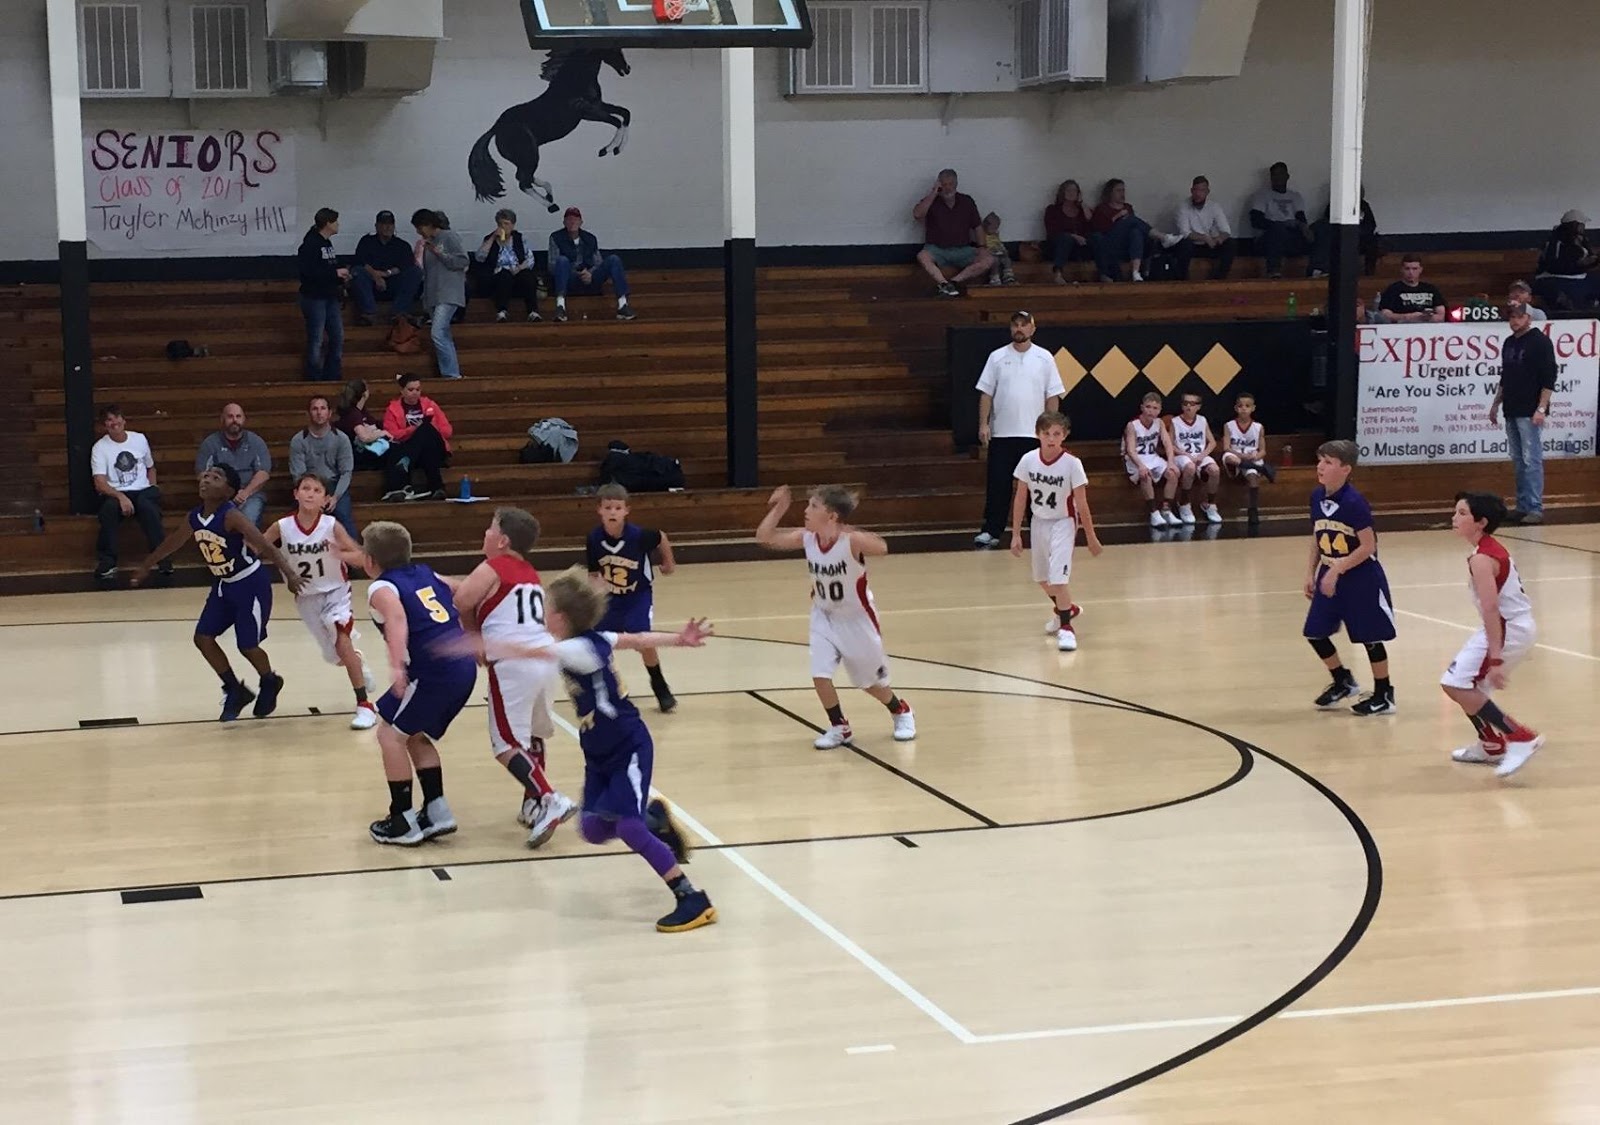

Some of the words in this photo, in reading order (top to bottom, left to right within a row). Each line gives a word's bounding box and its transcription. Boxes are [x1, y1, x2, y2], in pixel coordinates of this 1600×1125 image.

[91, 129, 280, 187] SENIORS
[99, 175, 152, 202] Class
[165, 175, 184, 205] of
[201, 176, 245, 203] 2017
[91, 204, 169, 239] Tayler
[176, 207, 247, 236] McKinzy
[255, 207, 286, 232] Hill
[1354, 327, 1499, 378] Express
[1541, 321, 1597, 358] ed
[1418, 362, 1471, 381] Urgent
[1475, 362, 1503, 376] Car
[1405, 385, 1431, 398] You
[1436, 383, 1475, 397] Sick?
[1553, 380, 1581, 393] ck!”
[1138, 443, 1156, 455] 20
[1184, 442, 1202, 454] 25
[1374, 442, 1445, 459] Mustangs
[1449, 440, 1476, 454] and
[1481, 439, 1508, 453] Lad
[1543, 436, 1594, 454] stangs!
[1034, 489, 1057, 509] 24
[199, 541, 226, 563] 02
[1319, 532, 1350, 555] 44
[297, 558, 325, 579] 21
[603, 565, 628, 587] 12
[815, 580, 844, 601] 00
[415, 586, 450, 623] 5
[514, 587, 543, 624] 10
